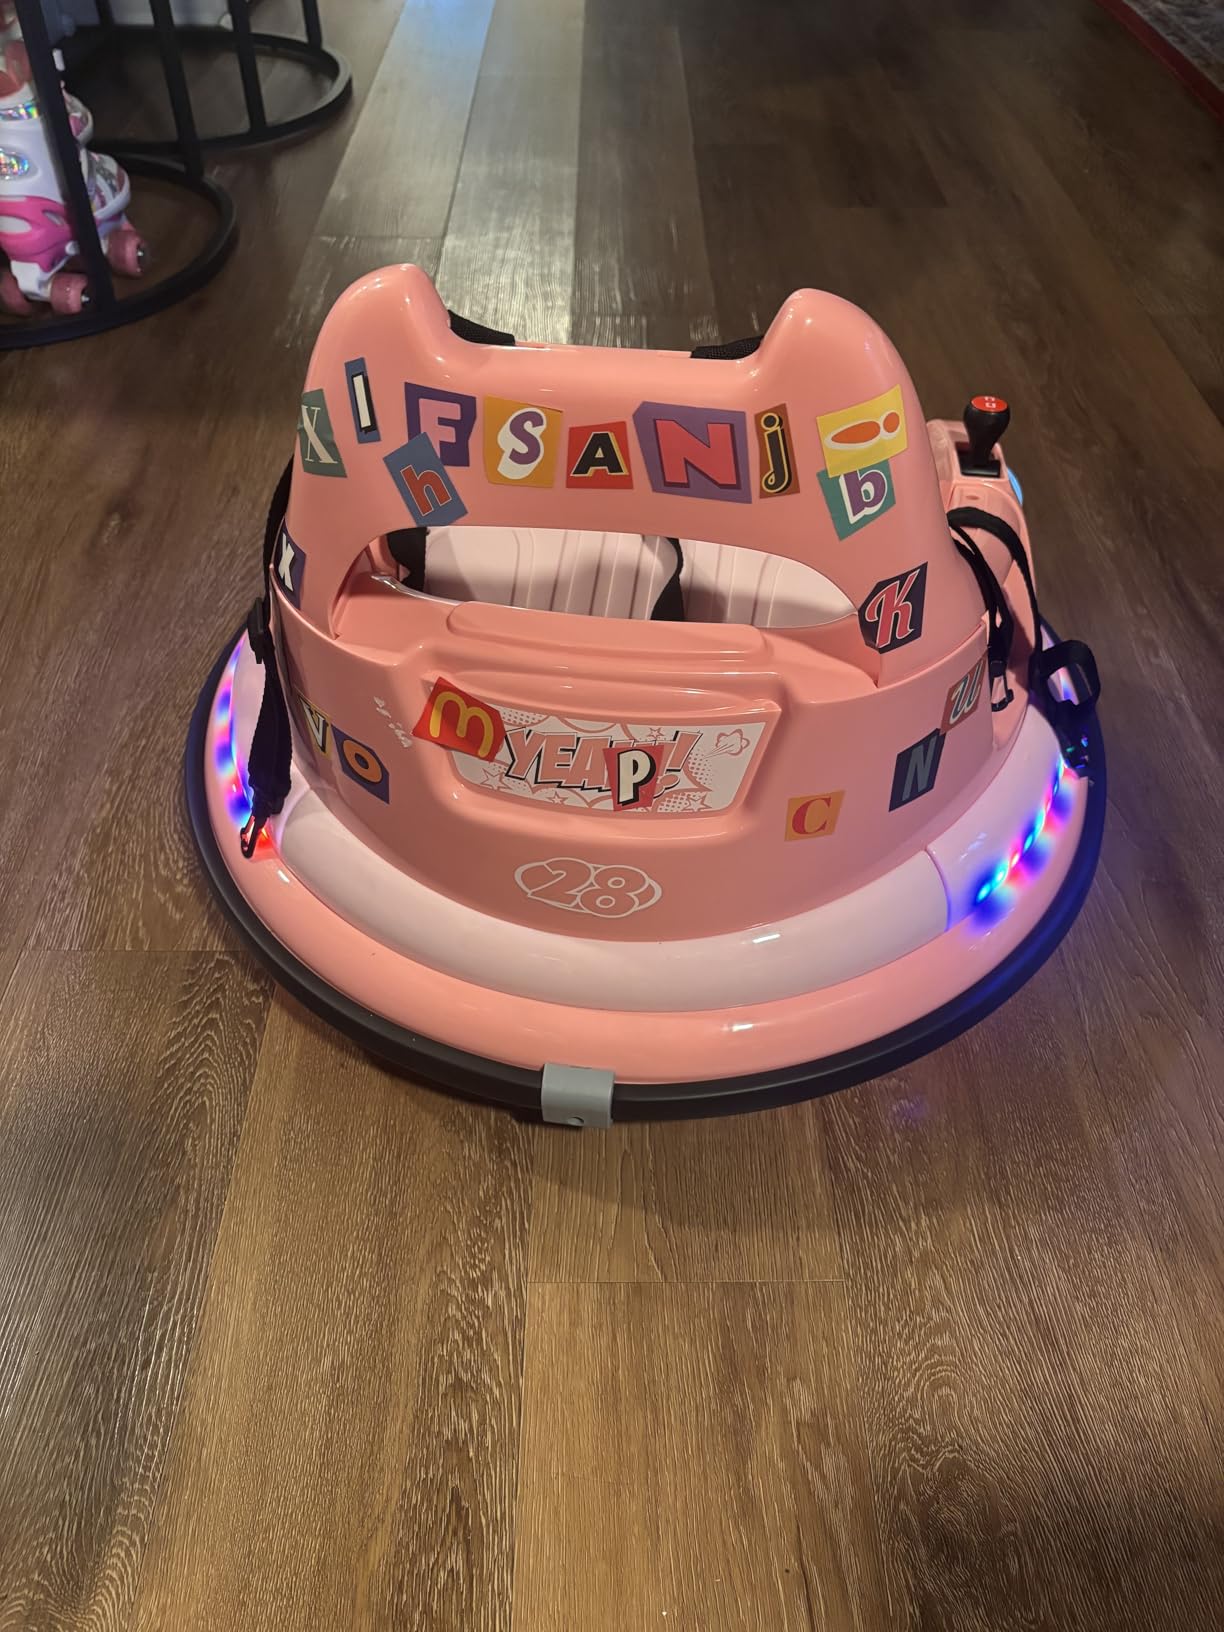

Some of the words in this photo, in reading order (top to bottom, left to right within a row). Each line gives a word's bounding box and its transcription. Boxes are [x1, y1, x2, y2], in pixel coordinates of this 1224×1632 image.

[418, 397, 462, 463] F
[498, 408, 547, 479] S
[570, 431, 629, 477] A
[655, 418, 742, 490] N
[761, 412, 793, 494] j
[400, 465, 452, 516] h
[839, 469, 889, 525] b
[865, 568, 920, 649] K
[505, 727, 703, 793] YEA!
[617, 749, 656, 807] P
[901, 735, 935, 802] N
[791, 796, 832, 836] C
[517, 858, 658, 918] 28
